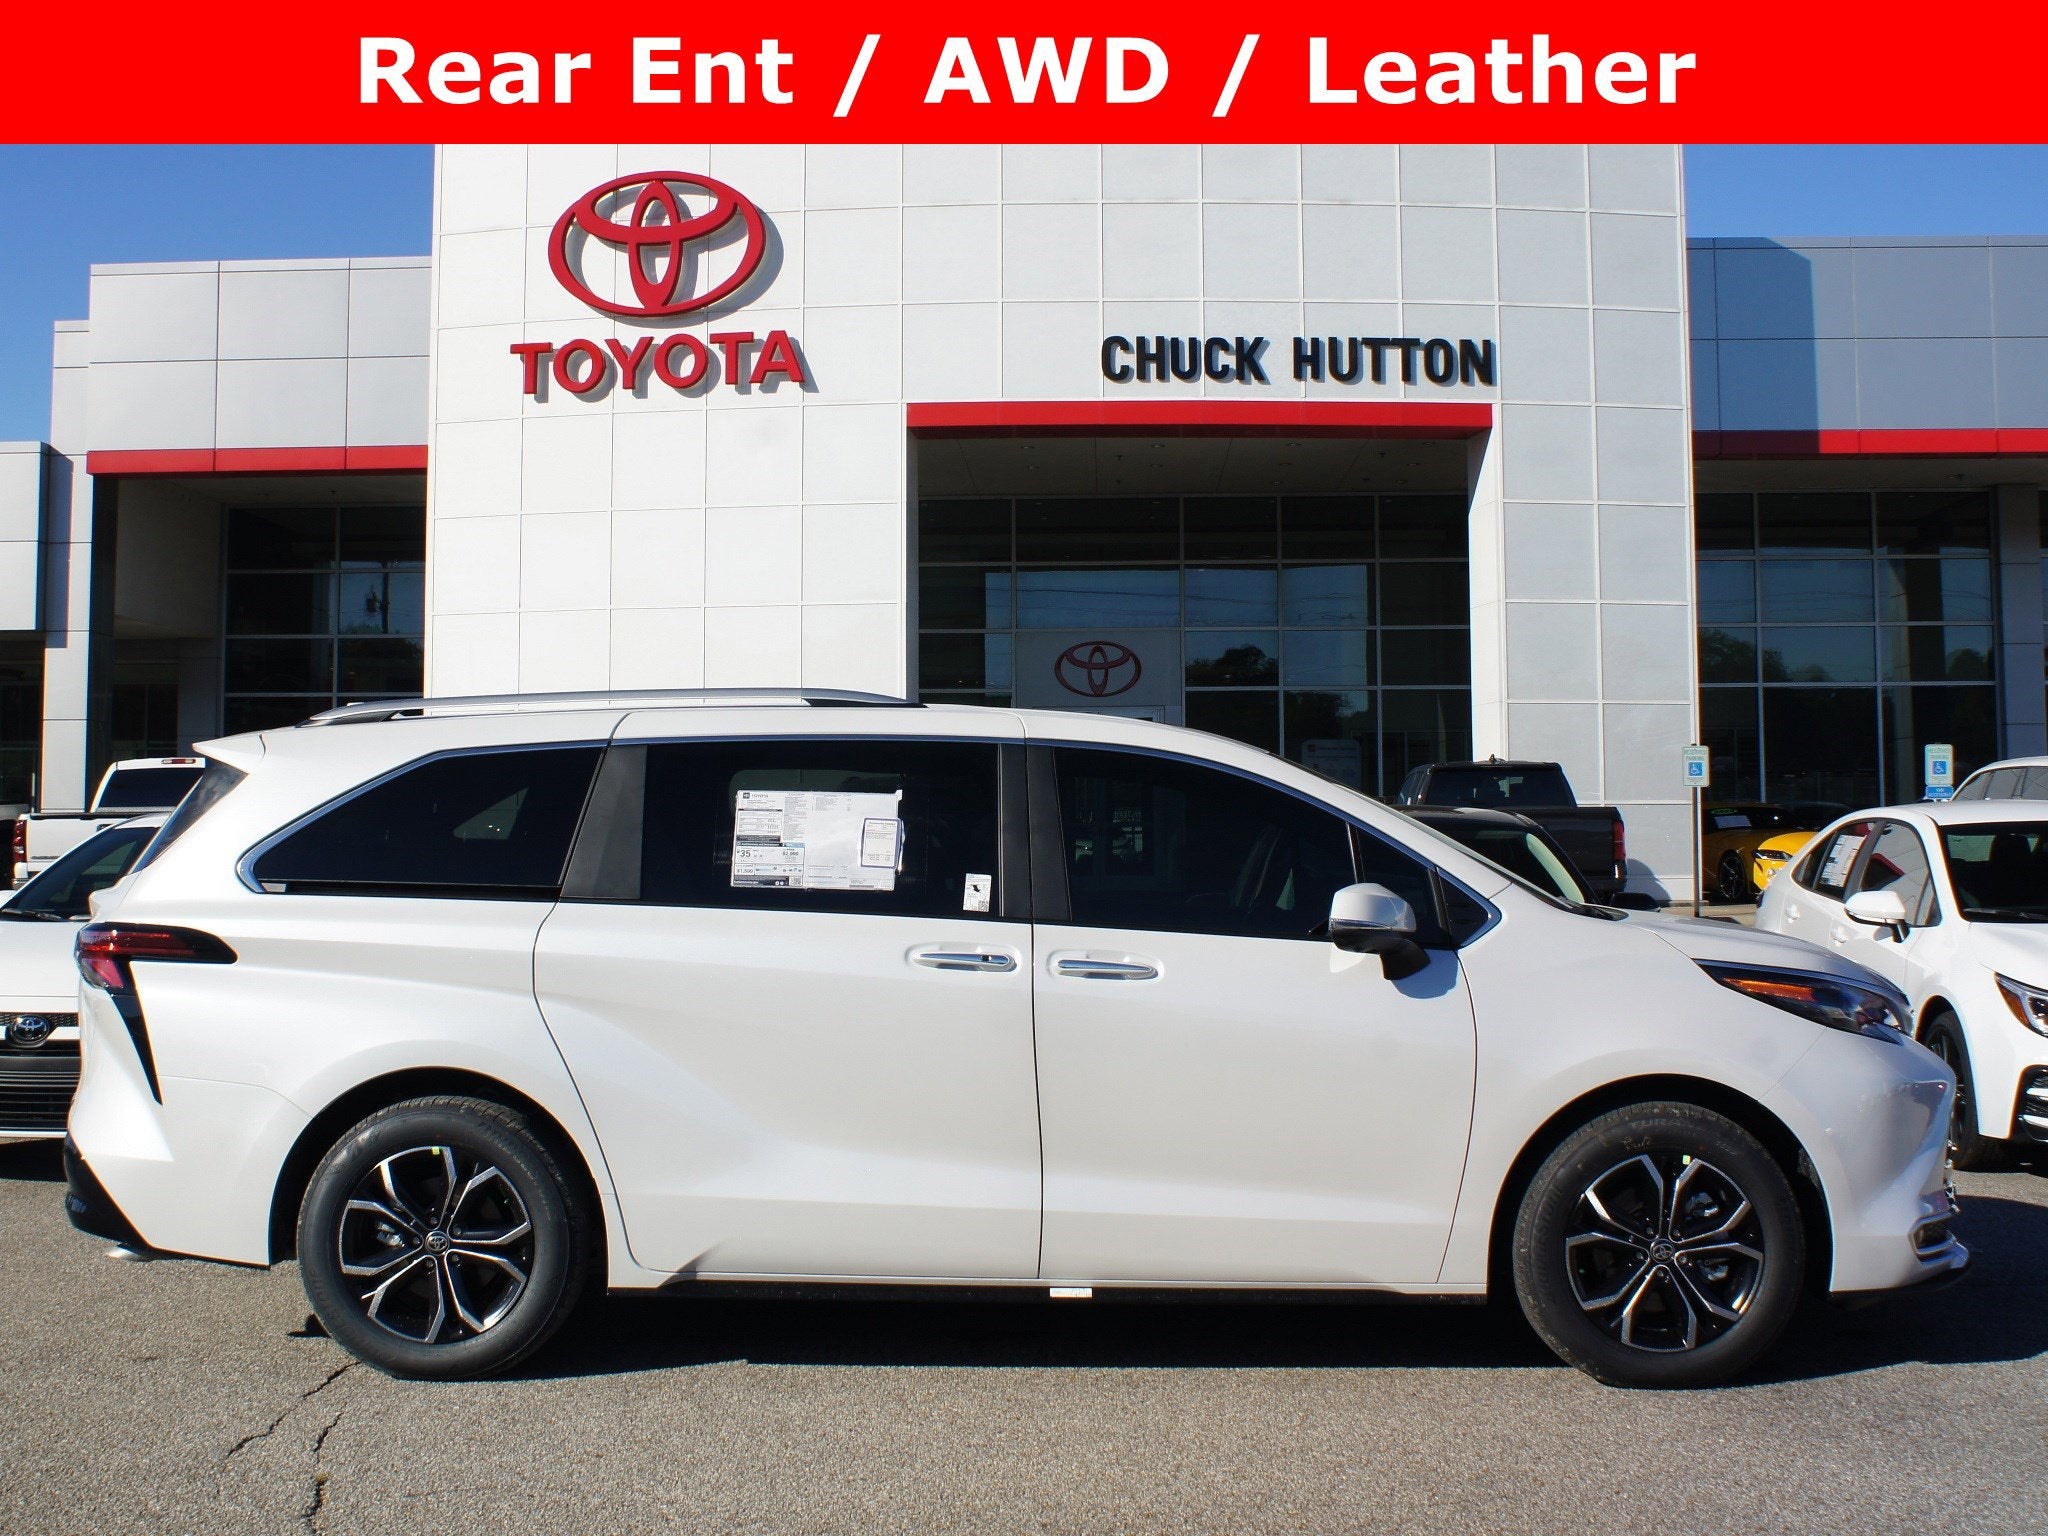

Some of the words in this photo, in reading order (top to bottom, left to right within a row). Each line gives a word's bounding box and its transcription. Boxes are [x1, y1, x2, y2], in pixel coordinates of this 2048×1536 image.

[510, 330, 807, 396] TOYOTA
[1101, 335, 1267, 383] CHUCK
[1293, 336, 1494, 385] HUTTON
[740, 849, 751, 857] 35
